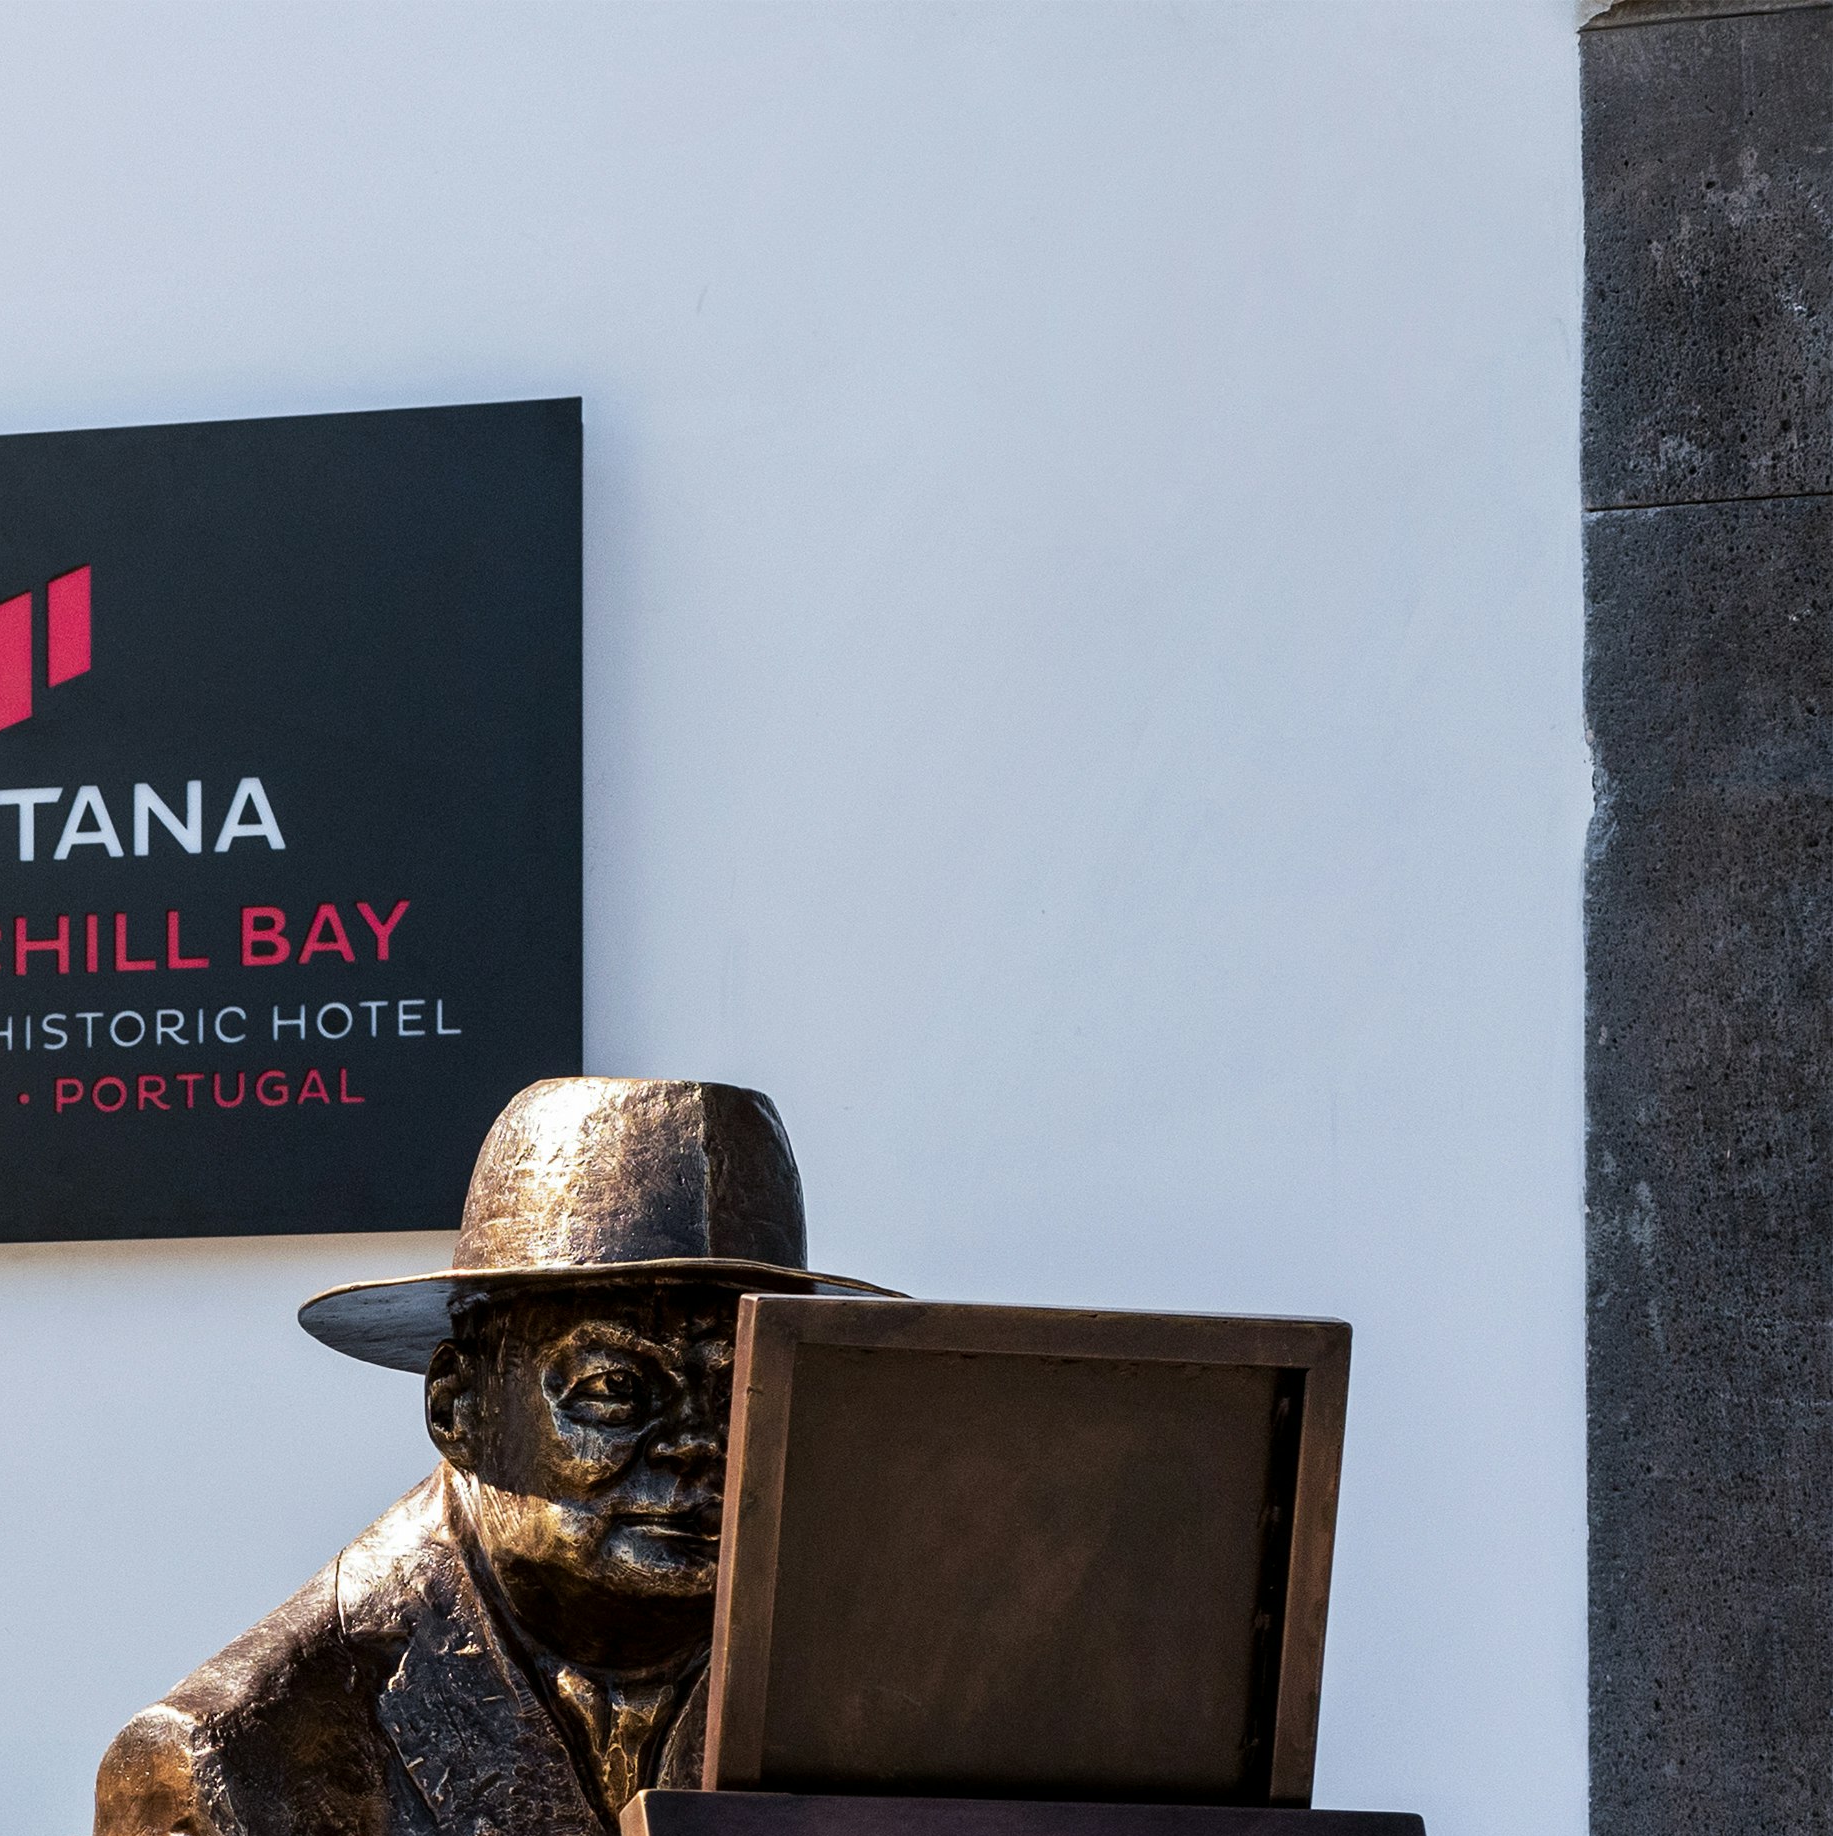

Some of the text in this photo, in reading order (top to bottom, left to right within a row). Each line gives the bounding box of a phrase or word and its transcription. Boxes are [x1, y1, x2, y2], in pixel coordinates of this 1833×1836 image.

[239, 899, 411, 968] BAY
[271, 998, 463, 1042] HOTEL
[54, 1067, 366, 1114] PORTUGAL
